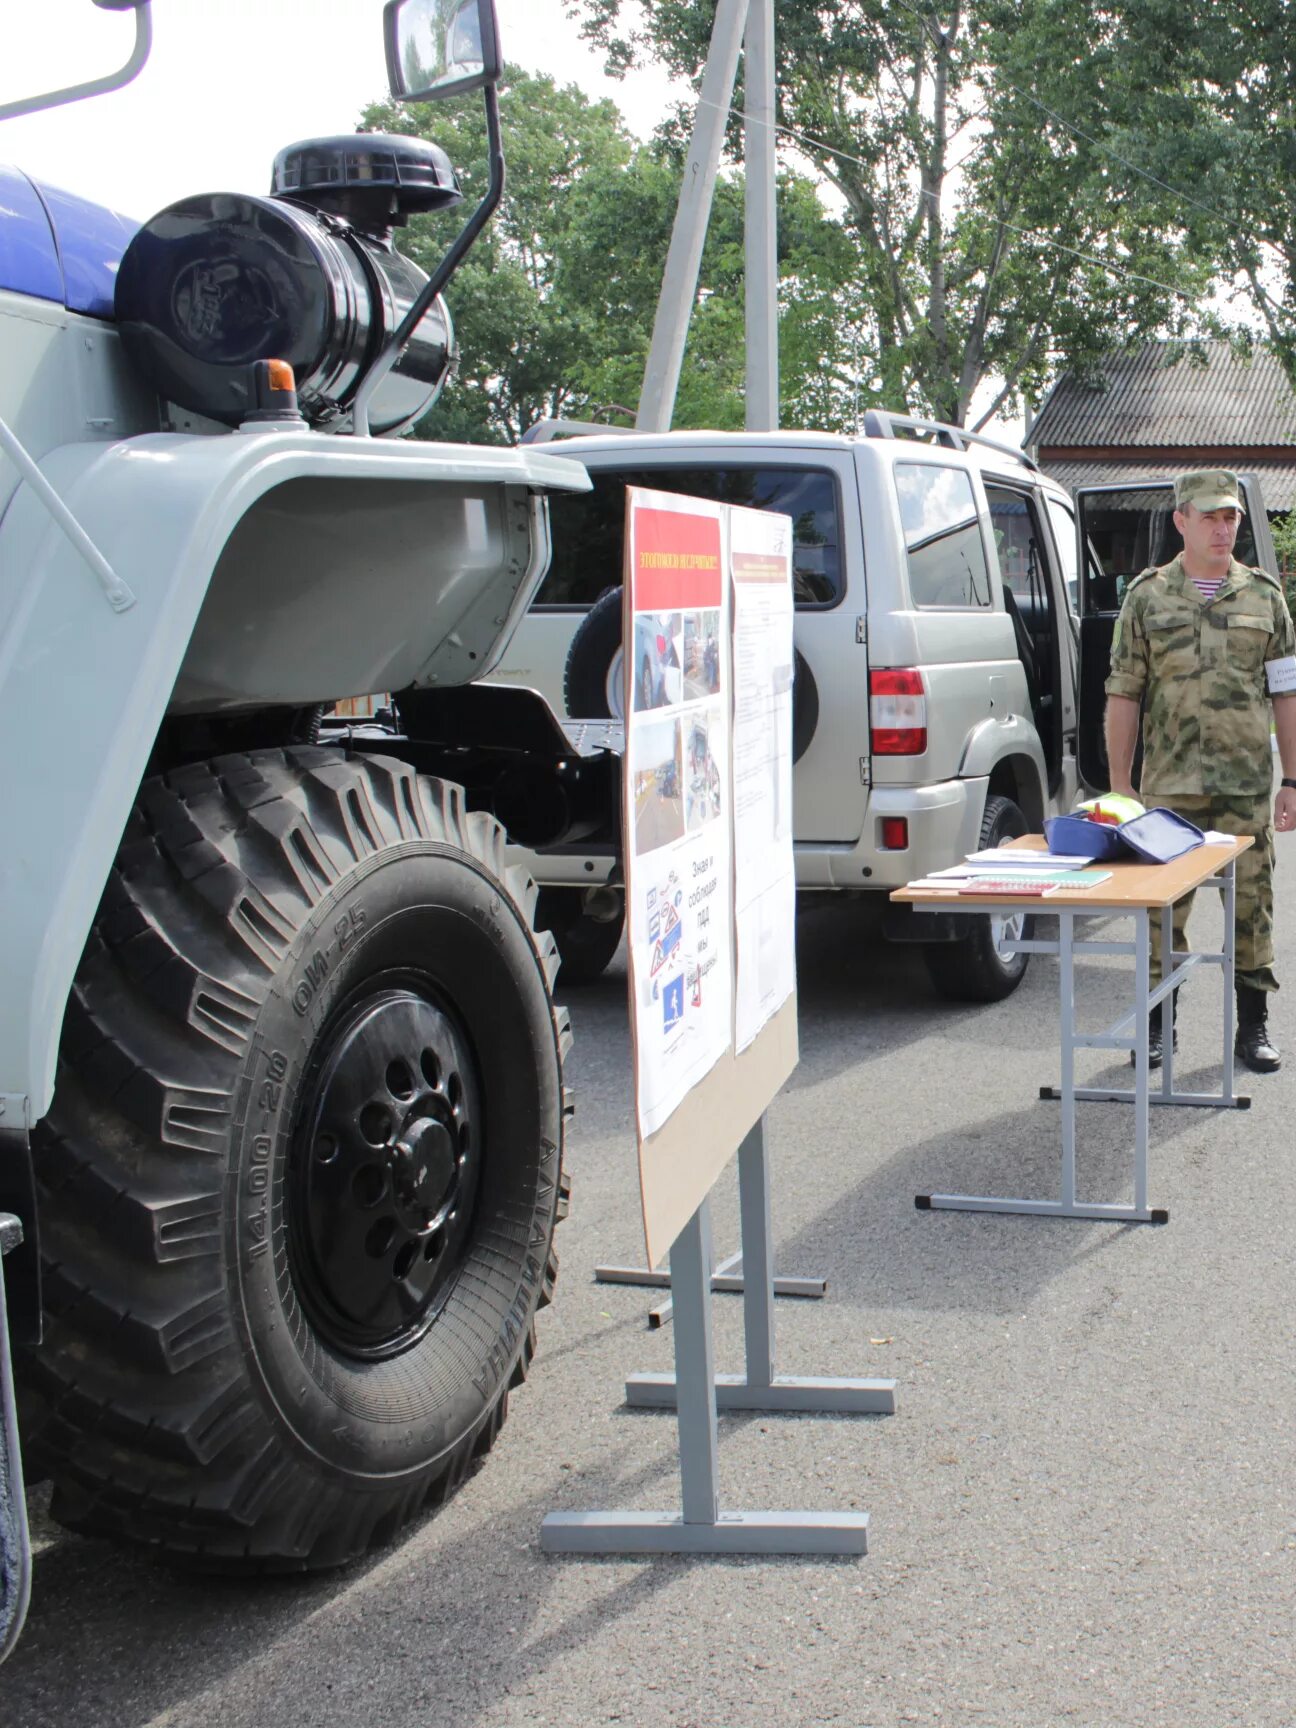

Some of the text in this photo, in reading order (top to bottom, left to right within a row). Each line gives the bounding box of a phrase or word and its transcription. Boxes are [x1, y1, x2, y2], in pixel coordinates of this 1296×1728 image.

[692, 857, 708, 878] Зная
[688, 877, 718, 908] соблюдая
[697, 906, 710, 929] ПДД
[697, 937, 709, 953] мы
